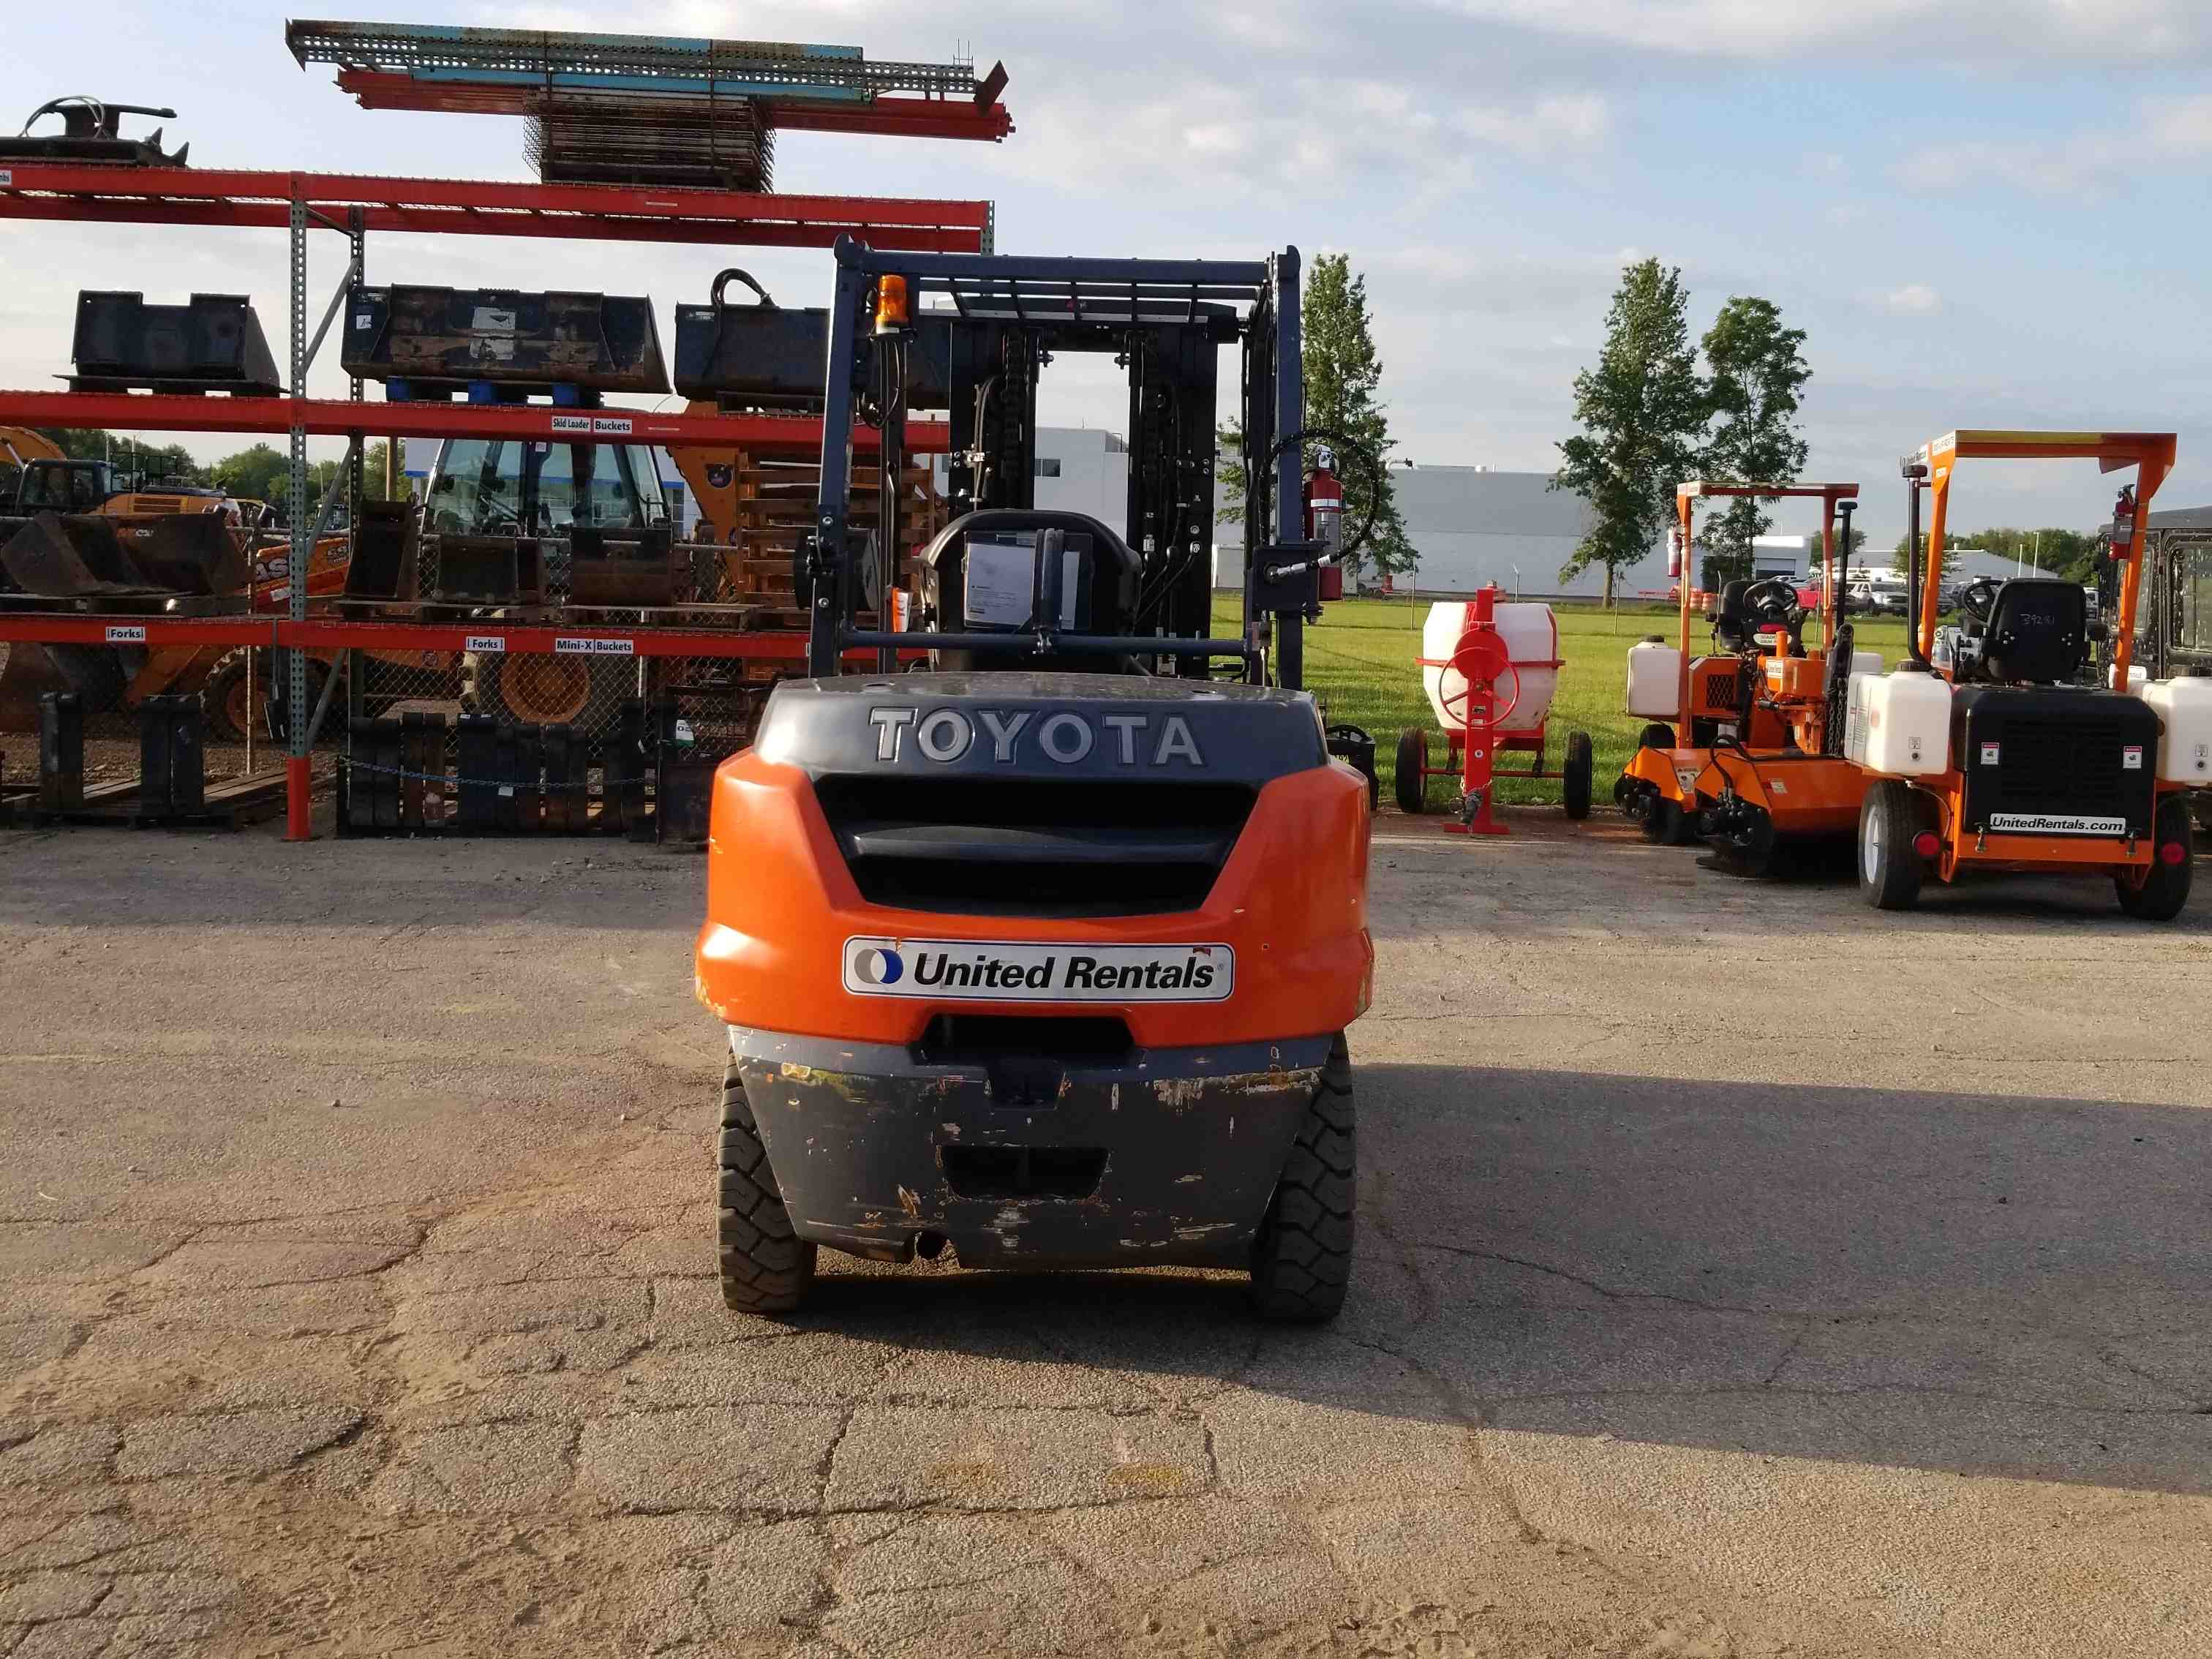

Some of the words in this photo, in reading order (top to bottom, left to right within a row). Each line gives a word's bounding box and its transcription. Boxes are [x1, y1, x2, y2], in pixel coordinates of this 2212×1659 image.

[553, 418, 565, 428] Skid
[568, 418, 589, 429] Loader
[595, 421, 631, 431] Buckets
[110, 628, 141, 638] Forks
[473, 639, 498, 649] Forks
[557, 639, 592, 650] Mini-X
[597, 642, 632, 651] Buckets
[869, 707, 1205, 766] TOYOTA
[1992, 816, 2123, 831] UnitedRentals.com
[914, 952, 1056, 989] United
[1064, 956, 1214, 990] Rentals
